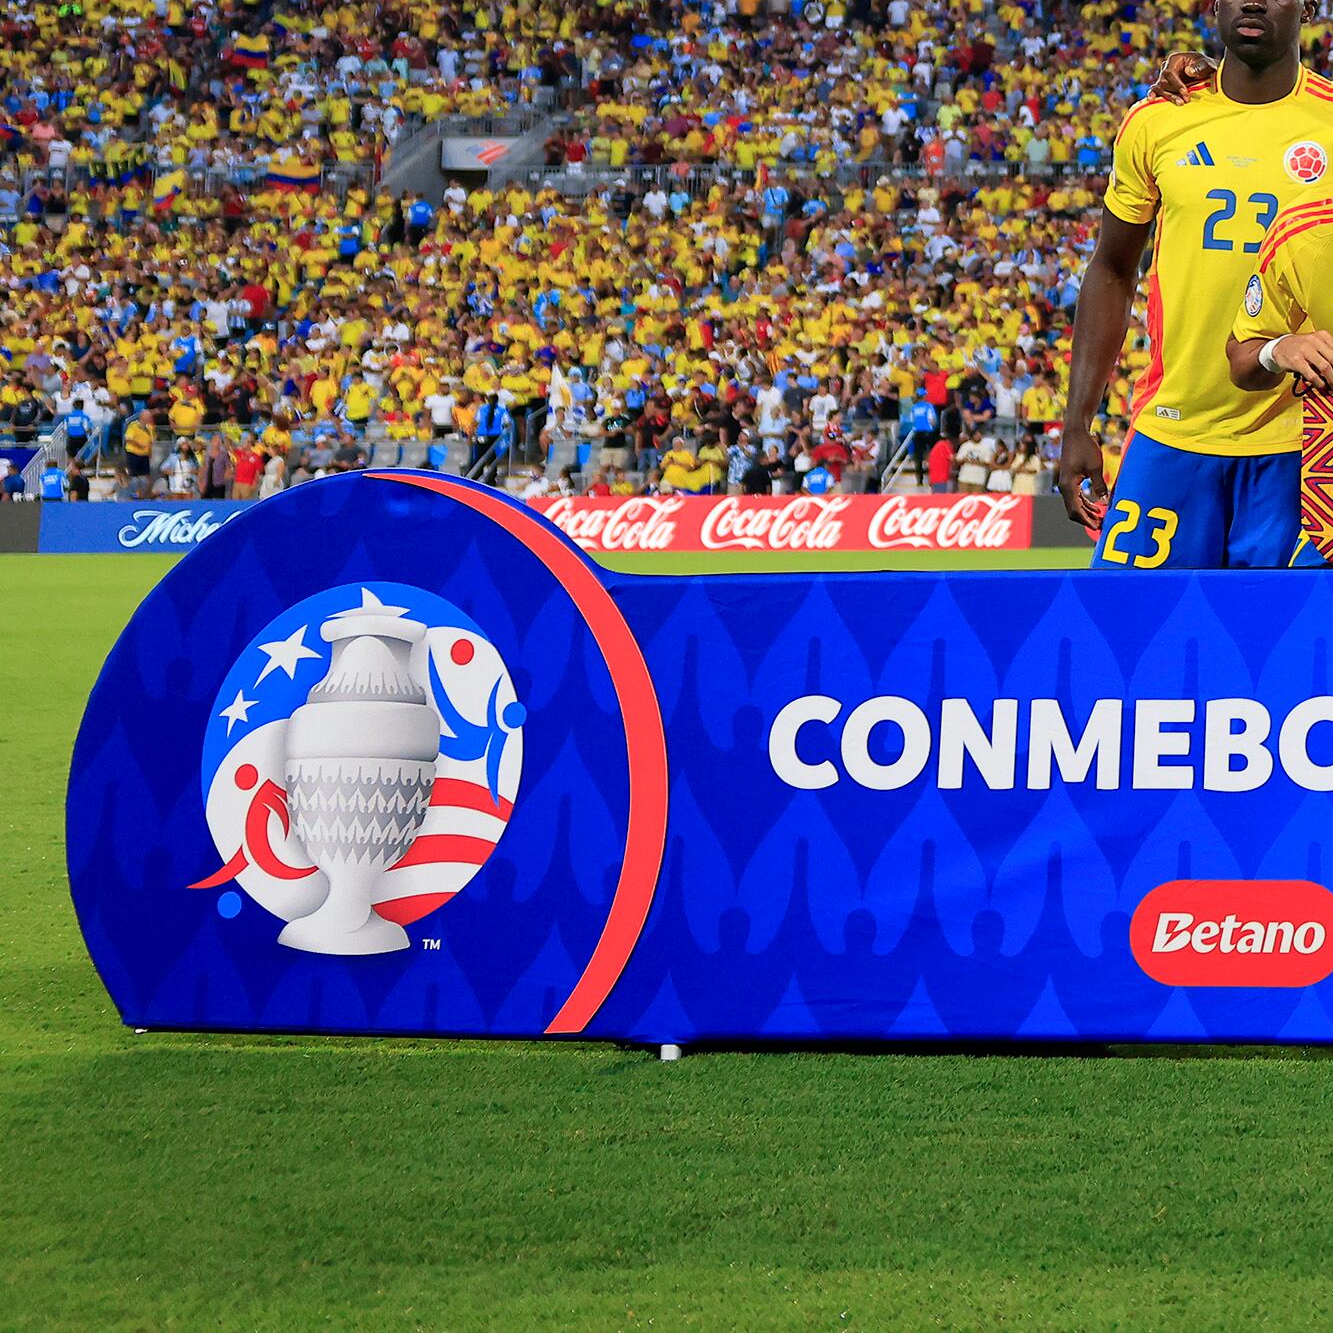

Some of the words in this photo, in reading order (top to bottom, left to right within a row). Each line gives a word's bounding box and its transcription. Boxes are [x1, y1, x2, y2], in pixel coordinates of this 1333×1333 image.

[1202, 188, 1279, 254] 23
[118, 509, 242, 548] Mich
[543, 497, 686, 550] Coca-Cola
[700, 495, 856, 551] Coca-Cola
[867, 494, 1021, 550] Coca-Cola
[1101, 499, 1180, 569] 23
[422, 938, 441, 950] TM
[1153, 914, 1325, 953] Betano
